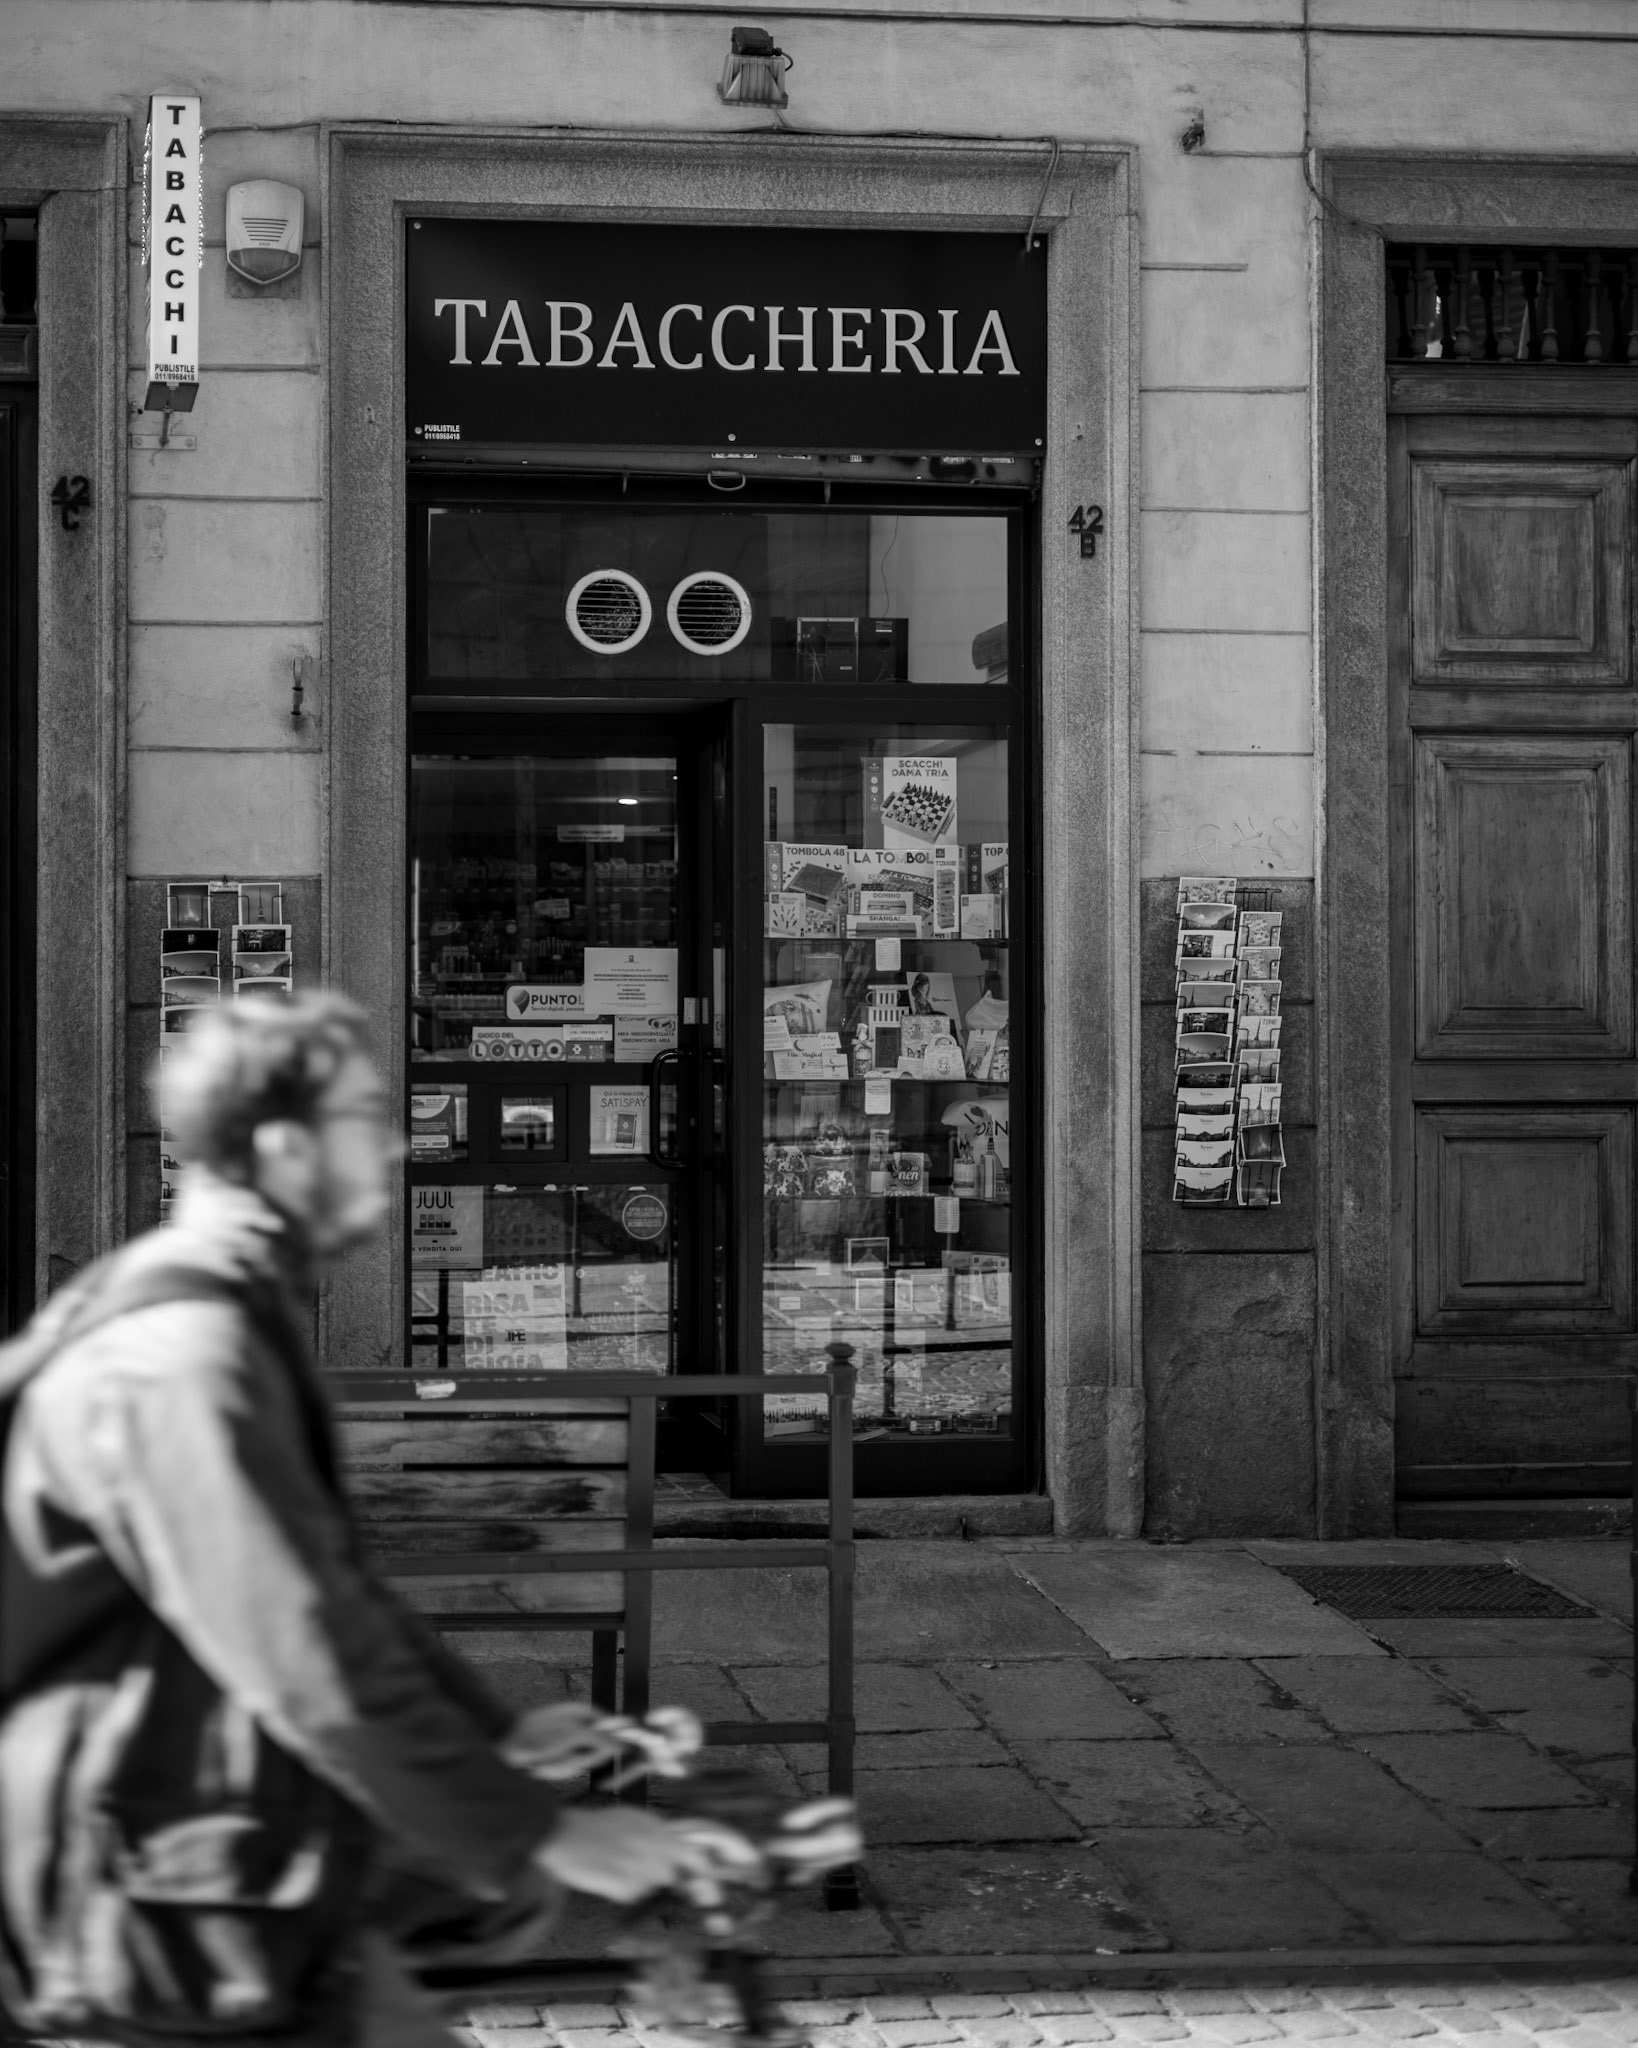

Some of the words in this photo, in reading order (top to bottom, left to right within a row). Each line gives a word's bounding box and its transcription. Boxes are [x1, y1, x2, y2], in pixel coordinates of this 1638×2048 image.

[164, 104, 187, 355] TABACCHI
[434, 298, 1021, 375] TABACCHERIA
[155, 363, 195, 373] PUBLISTILE
[154, 373, 195, 381] 011/8968418
[424, 424, 460, 432] PUBLISTILE
[51, 475, 90, 501] 42
[1068, 504, 1104, 531] 42
[1081, 532, 1096, 559] B
[898, 760, 943, 768] SCACCHI
[891, 768, 922, 777] DAMA
[925, 768, 949, 777] TRIA
[785, 847, 831, 857] TOMBOLA
[833, 848, 845, 857] 48
[853, 852, 871, 863] LA
[984, 847, 1003, 856] TOP
[471, 1041, 562, 1059] LOTTO
[600, 1097, 647, 1108] SATISPAY
[416, 1191, 455, 1209] JUUL
[464, 1293, 530, 1314] RISA
[465, 1336, 494, 1355] DI
